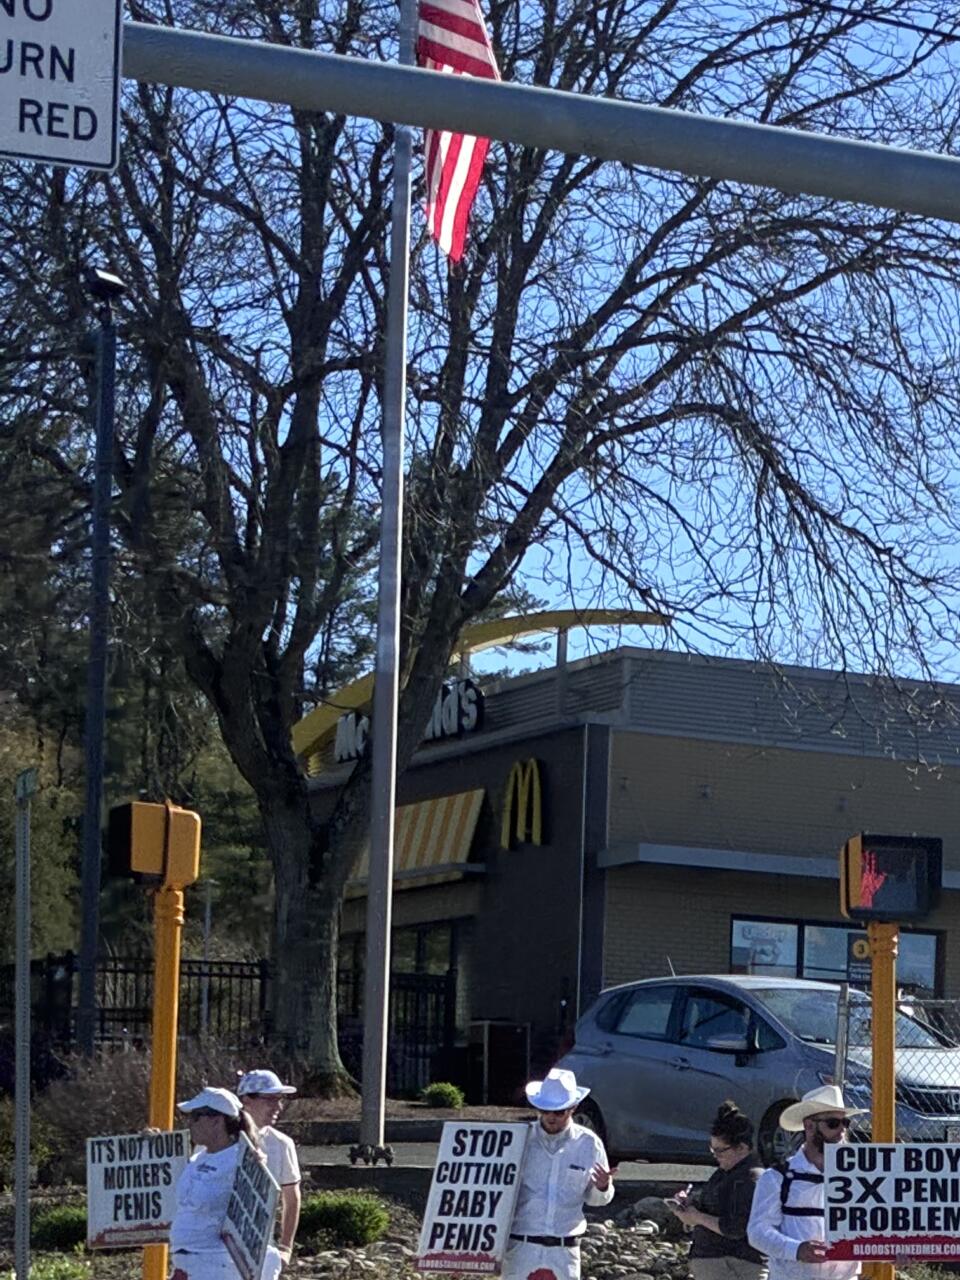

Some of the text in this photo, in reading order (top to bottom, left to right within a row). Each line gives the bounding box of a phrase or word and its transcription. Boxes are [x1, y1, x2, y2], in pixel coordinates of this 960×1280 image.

[0, 39, 75, 83] URN
[19, 98, 98, 141] RED
[90, 1132, 184, 1164] IT'S NOT YOUR
[452, 1128, 513, 1158] STOP
[436, 1161, 517, 1186] CUTTING
[836, 1147, 896, 1172] CUT
[104, 1161, 172, 1190] MOTHER'S
[827, 1176, 887, 1204] 3X
[113, 1191, 162, 1221] PENIS
[437, 1189, 503, 1218] BABY
[428, 1222, 497, 1251] PENIS
